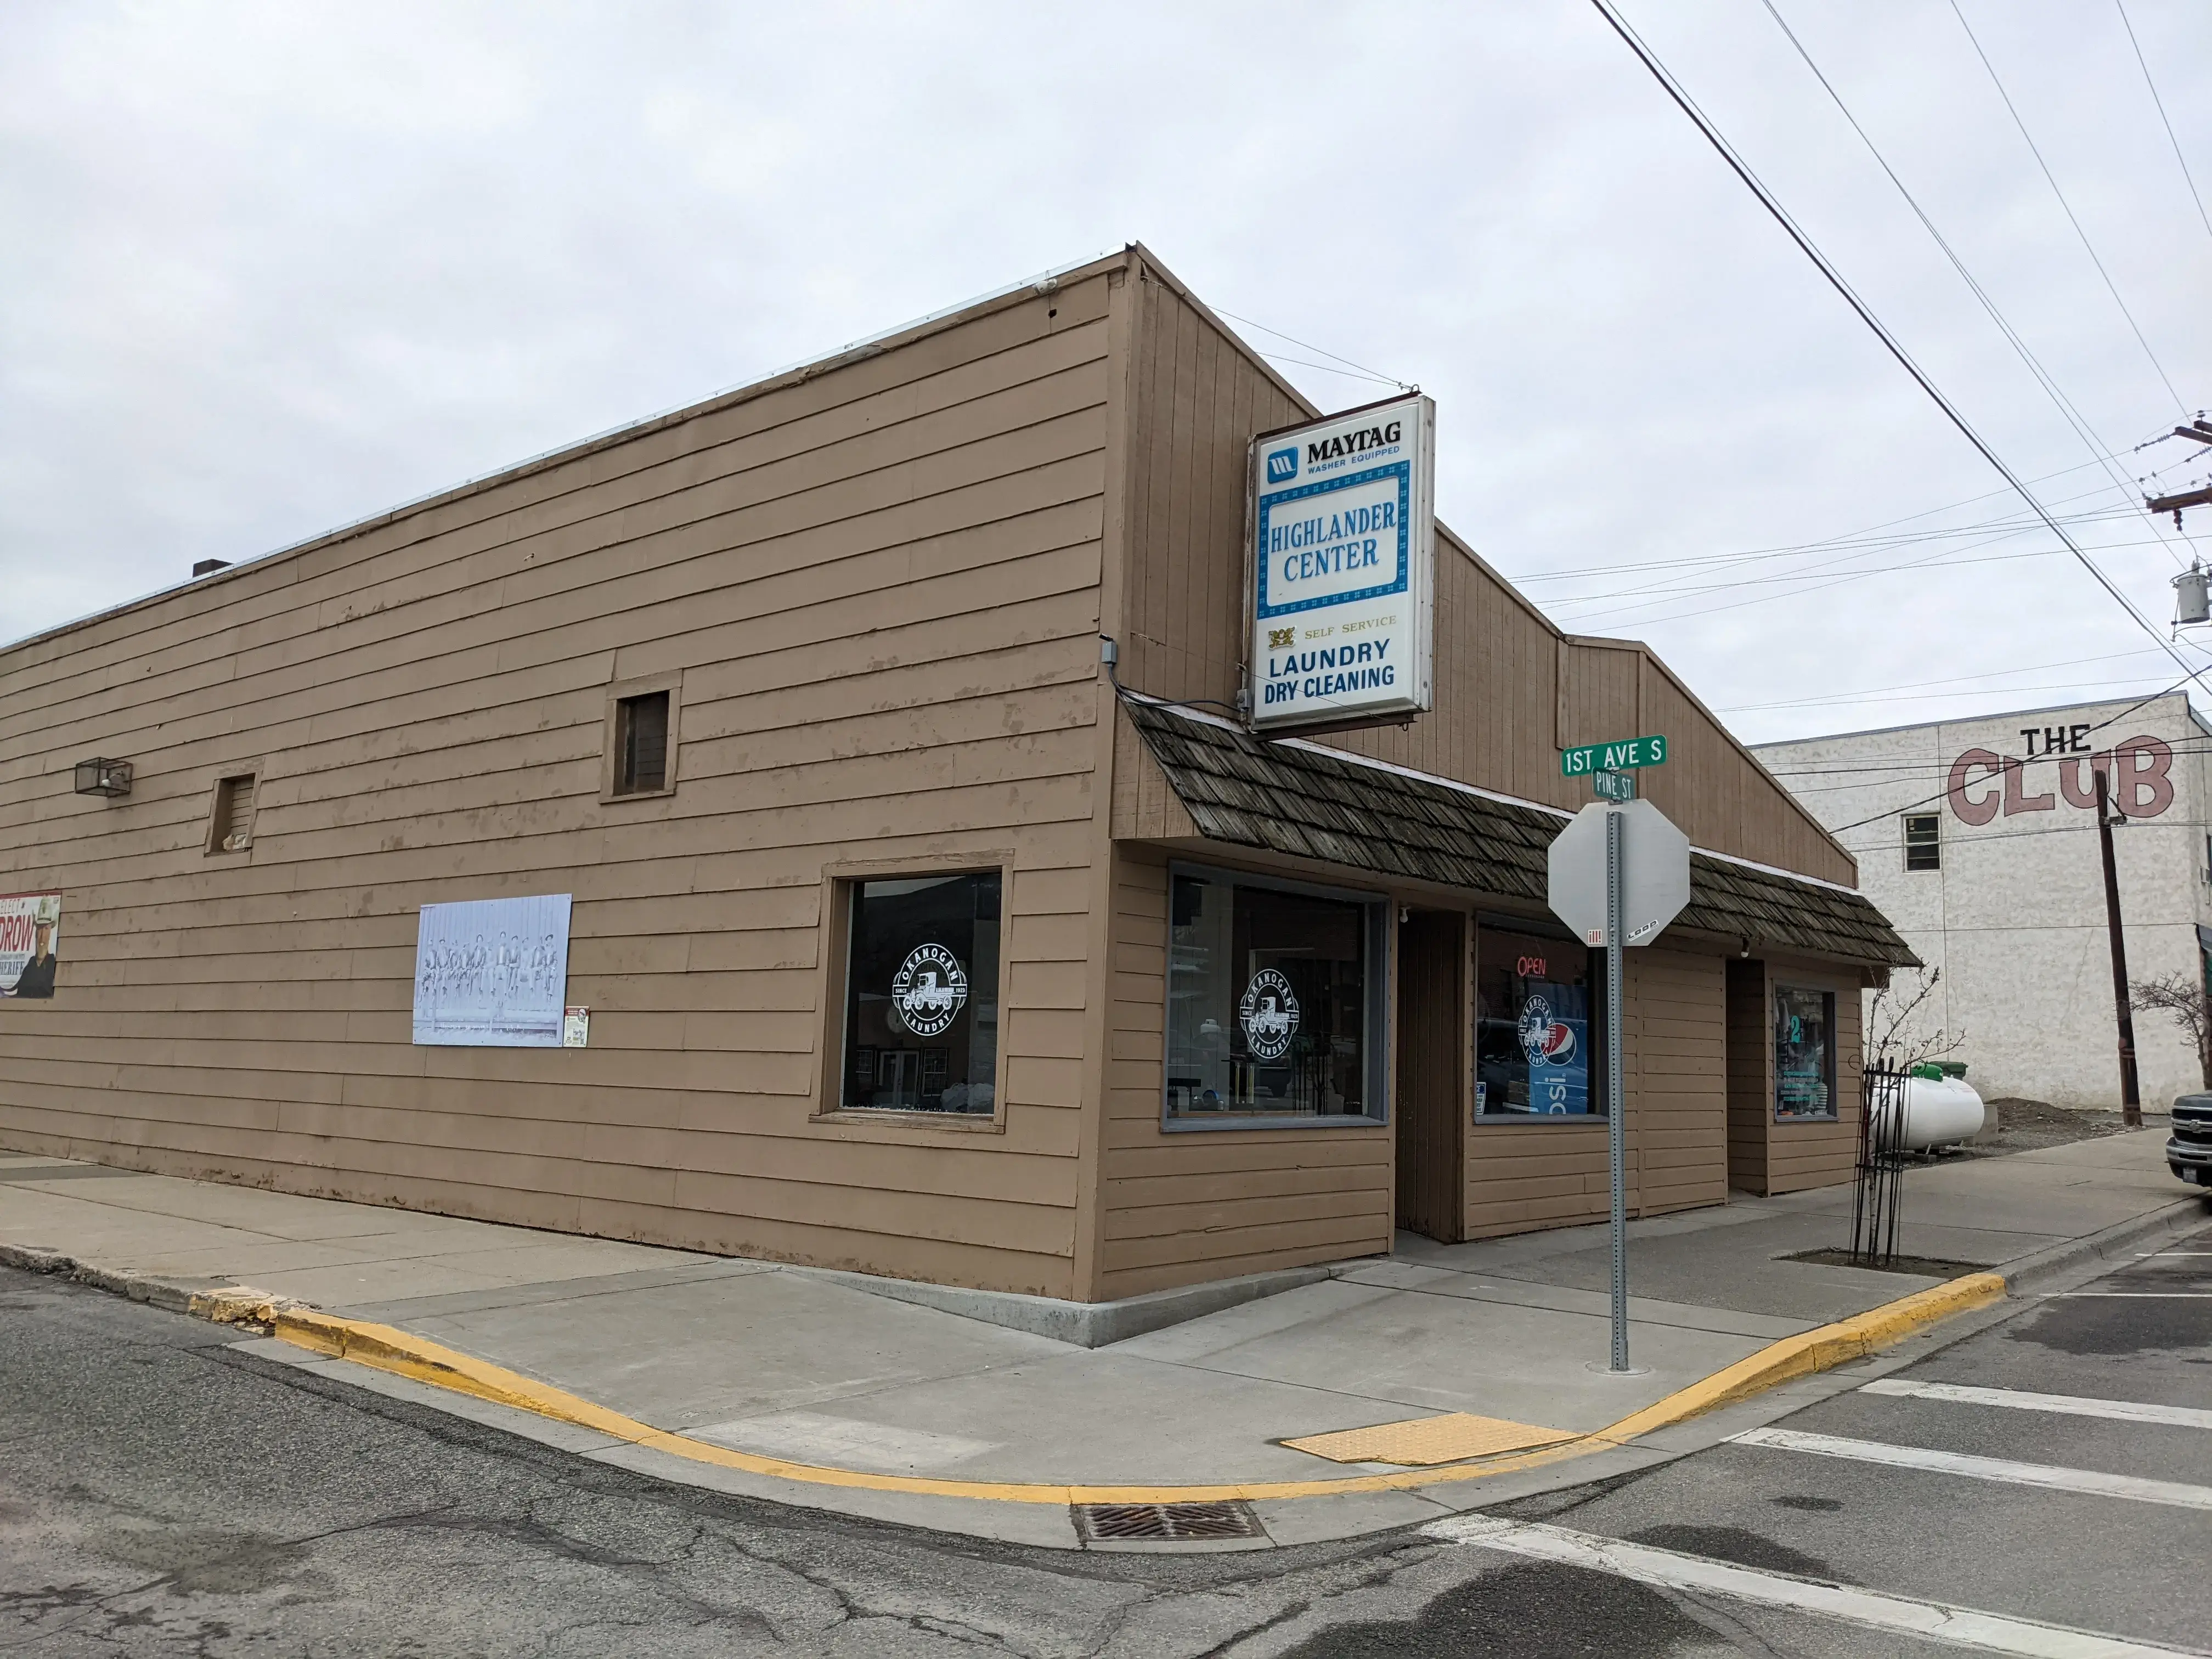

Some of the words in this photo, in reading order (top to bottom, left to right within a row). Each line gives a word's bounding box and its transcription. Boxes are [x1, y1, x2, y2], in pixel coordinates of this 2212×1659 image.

[1308, 421, 1401, 464] MAYTAG
[1308, 459, 1346, 474] WASHER
[1351, 446, 1400, 464] EQUIPPED
[1271, 501, 1397, 553] HIGHLANDER
[1284, 538, 1379, 582] CENTER
[1305, 627, 1334, 639] SELF
[1342, 616, 1396, 634] SERVICE
[1269, 638, 1390, 678] LAUNDRY
[1265, 681, 1297, 704] DRY
[1304, 665, 1394, 697] CLEANING
[2020, 724, 2091, 755] THE
[1566, 750, 1593, 772] 1ST
[1604, 743, 1639, 768] AVE
[1651, 740, 1661, 761] S
[1596, 771, 1617, 795] PINE
[1622, 777, 1631, 799] ST
[1948, 735, 2174, 826] CLUB
[902, 947, 958, 980] OKANOGAN
[1517, 956, 1546, 977] OPEN
[1248, 973, 1293, 1006] OKANOGAN
[906, 1012, 950, 1033] LAUNDRY
[1523, 998, 1551, 1026] OKANOGAN
[1251, 1035, 1286, 1056] LAUNDRY
[1526, 1048, 1548, 1064] LAUNDRY
